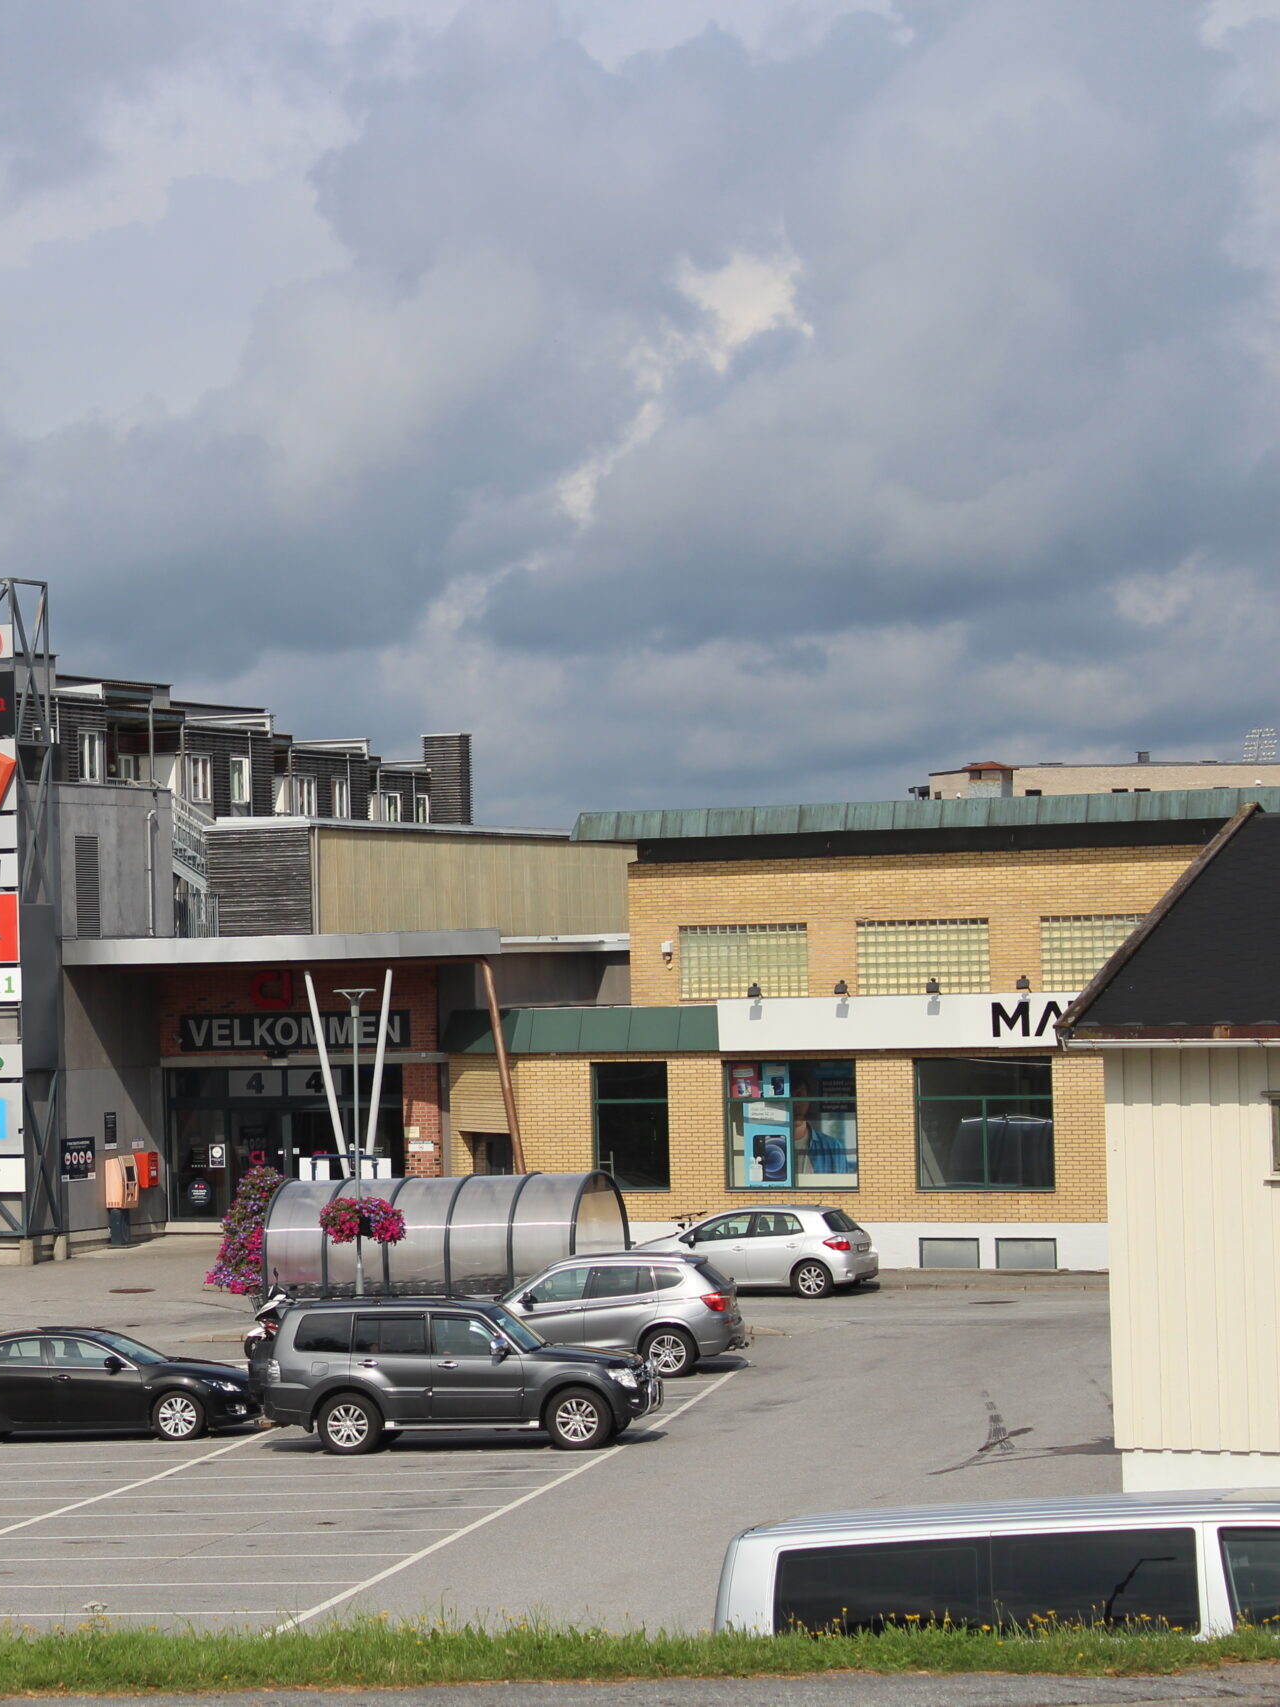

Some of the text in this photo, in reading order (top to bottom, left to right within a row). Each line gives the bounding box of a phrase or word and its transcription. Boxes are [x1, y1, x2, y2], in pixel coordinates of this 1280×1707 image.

[4, 975, 16, 994] 1
[187, 1015, 401, 1047] VELKOMMEN
[991, 1000, 1075, 1038] MA
[246, 1070, 324, 1095] 4 4
